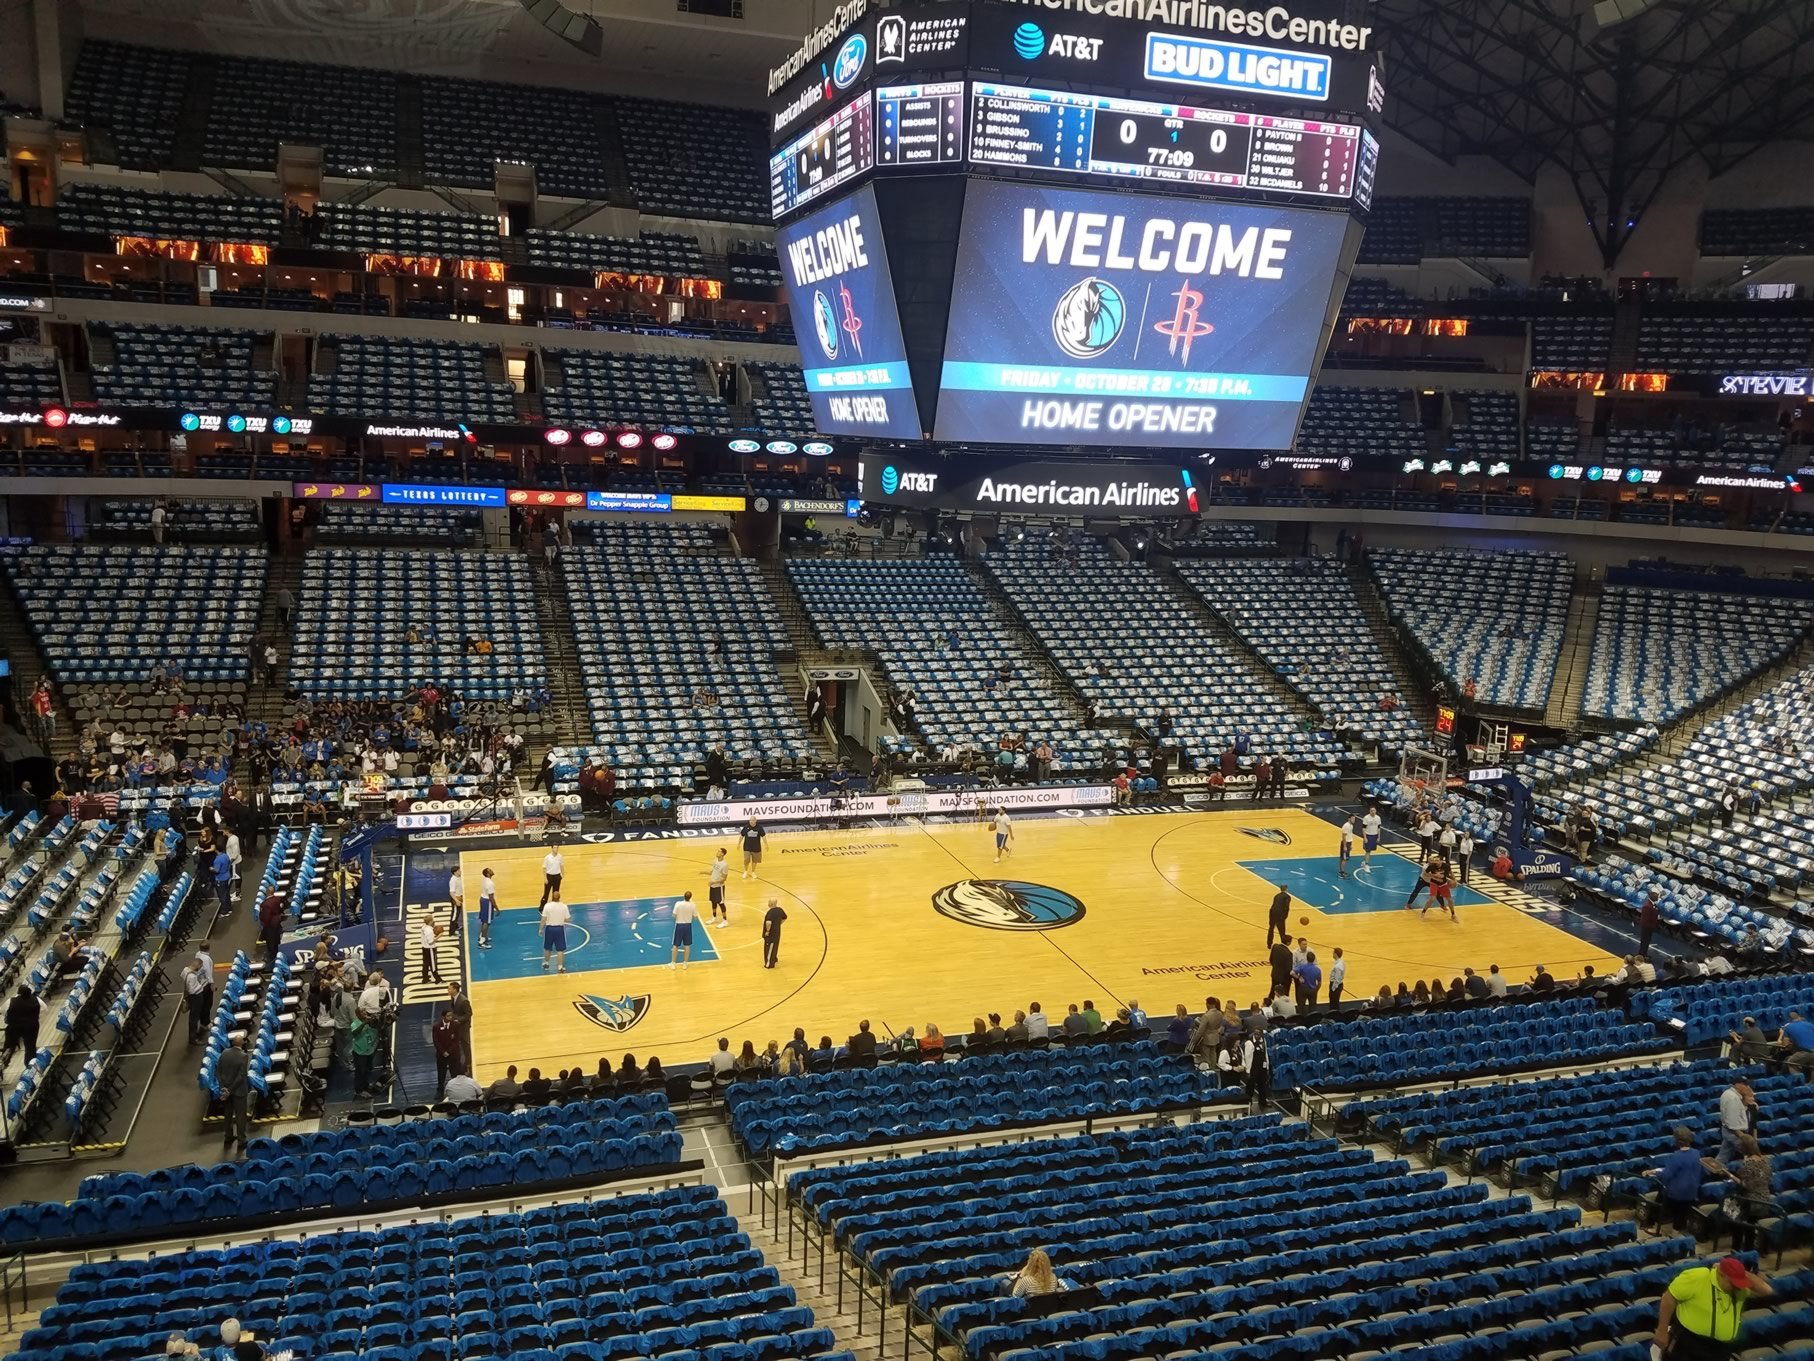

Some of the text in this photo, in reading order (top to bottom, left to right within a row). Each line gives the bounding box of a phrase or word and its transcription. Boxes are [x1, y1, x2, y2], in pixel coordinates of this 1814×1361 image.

[910, 18, 966, 31] AMERICAN
[909, 30, 960, 42] AIRLINES
[1048, 34, 1104, 61] AT&T
[1152, 42, 1224, 79] BUD
[774, 82, 822, 132] American Airlines
[905, 102, 931, 110] ASSISTS
[988, 99, 1050, 113] COLLINSWORTH
[987, 112, 1020, 123] GIBSON
[1194, 110, 1236, 123] ROCKETS
[1164, 118, 1184, 129] QTR
[986, 125, 1030, 137] BRUSSINO
[1120, 119, 1137, 144] 0
[1170, 131, 1178, 142] 1
[1265, 130, 1296, 140] PAYTON
[974, 137, 984, 146] 10
[985, 138, 1043, 152] FINNEY-SMITH
[1210, 129, 1227, 153] 0
[1264, 142, 1293, 152] BROWN
[972, 149, 983, 158] 20
[984, 150, 1027, 163] HAMMONS
[1148, 148, 1194, 167] 77:09
[1263, 155, 1295, 165] ONUAKU
[1251, 165, 1260, 173] 30
[1261, 166, 1293, 177] WILTJER
[1249, 176, 1259, 185] 32
[1260, 178, 1303, 189] MCDANIELS
[788, 214, 868, 287] WELCOME
[1022, 208, 1292, 280] WELCOME
[1000, 370, 1060, 387] FRIDAY
[1075, 373, 1148, 391] OCTOBER
[1220, 379, 1252, 395] P.M.
[1719, 376, 1807, 394] STEVIE
[829, 396, 889, 423] HOME OPENER
[1022, 400, 1216, 432] HOME OPENER
[199, 416, 221, 425] TXU
[246, 417, 267, 426] TXU
[291, 419, 312, 428] TXU
[367, 424, 459, 439] American Airlines
[1564, 466, 1583, 475] TXU
[1603, 468, 1622, 476] TXU
[1642, 470, 1662, 478] TXU
[900, 472, 938, 492] AT&T
[1696, 475, 1785, 489] American Airlines
[403, 490, 486, 501] TEXAS LOTTERY
[976, 478, 1180, 506] American Airlines
[794, 501, 844, 510] BACHENDORF'S
[1440, 709, 1454, 720] 77:09
[1438, 718, 1451, 732] 24
[1076, 787, 1101, 798] MAVS
[690, 805, 720, 816] MAVS
[1091, 804, 1203, 817] FANDUEL
[623, 826, 744, 840] FANDUE
[781, 842, 899, 854] AmericanAirlines
[1521, 862, 1561, 875] SPALDING
[1142, 959, 1271, 976] AmericanAirline
[1195, 970, 1251, 981] Center
